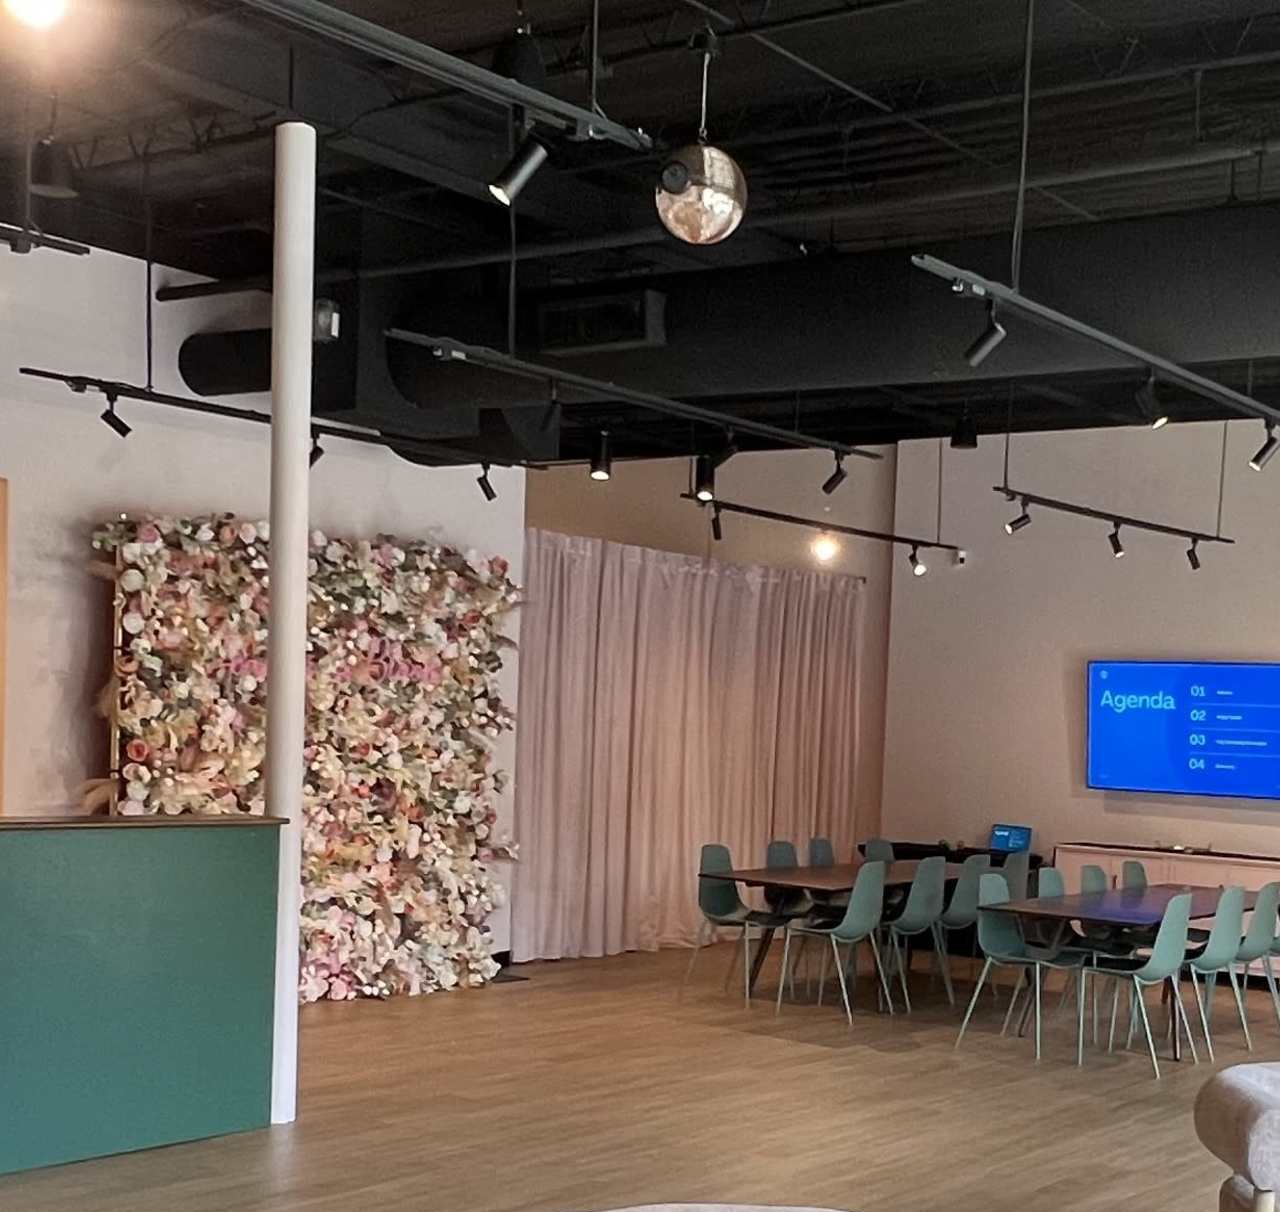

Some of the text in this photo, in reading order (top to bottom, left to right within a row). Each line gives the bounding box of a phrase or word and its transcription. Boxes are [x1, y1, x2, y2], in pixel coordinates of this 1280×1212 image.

[1190, 686, 1206, 697] 01
[1100, 690, 1176, 713] Agenda
[1190, 710, 1206, 721] 02
[1189, 734, 1206, 745] 03
[1188, 759, 1205, 770] 04
